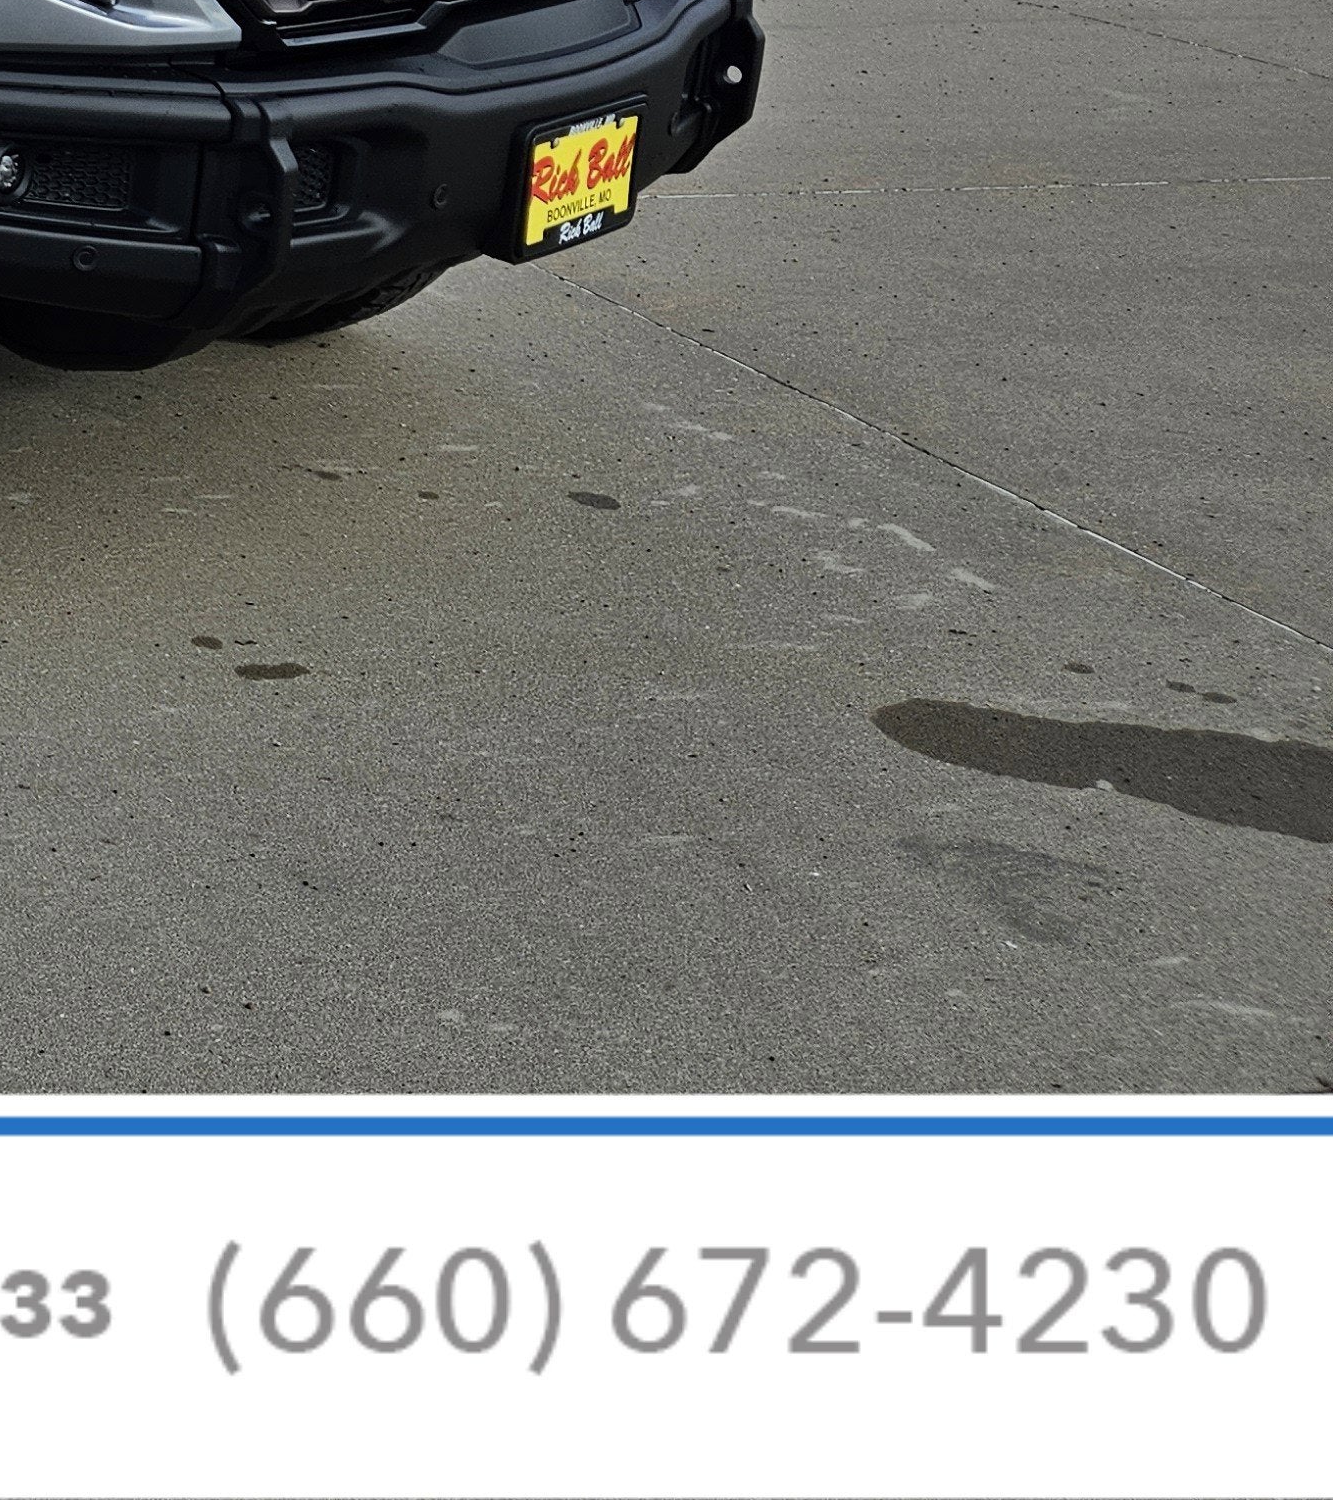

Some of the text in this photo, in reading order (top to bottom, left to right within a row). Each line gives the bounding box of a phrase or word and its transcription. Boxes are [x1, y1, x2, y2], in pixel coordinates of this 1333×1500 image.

[531, 133, 637, 204] Rick Ball
[546, 188, 612, 223] BOONVILLE, MO
[558, 211, 605, 245] Rick Ball
